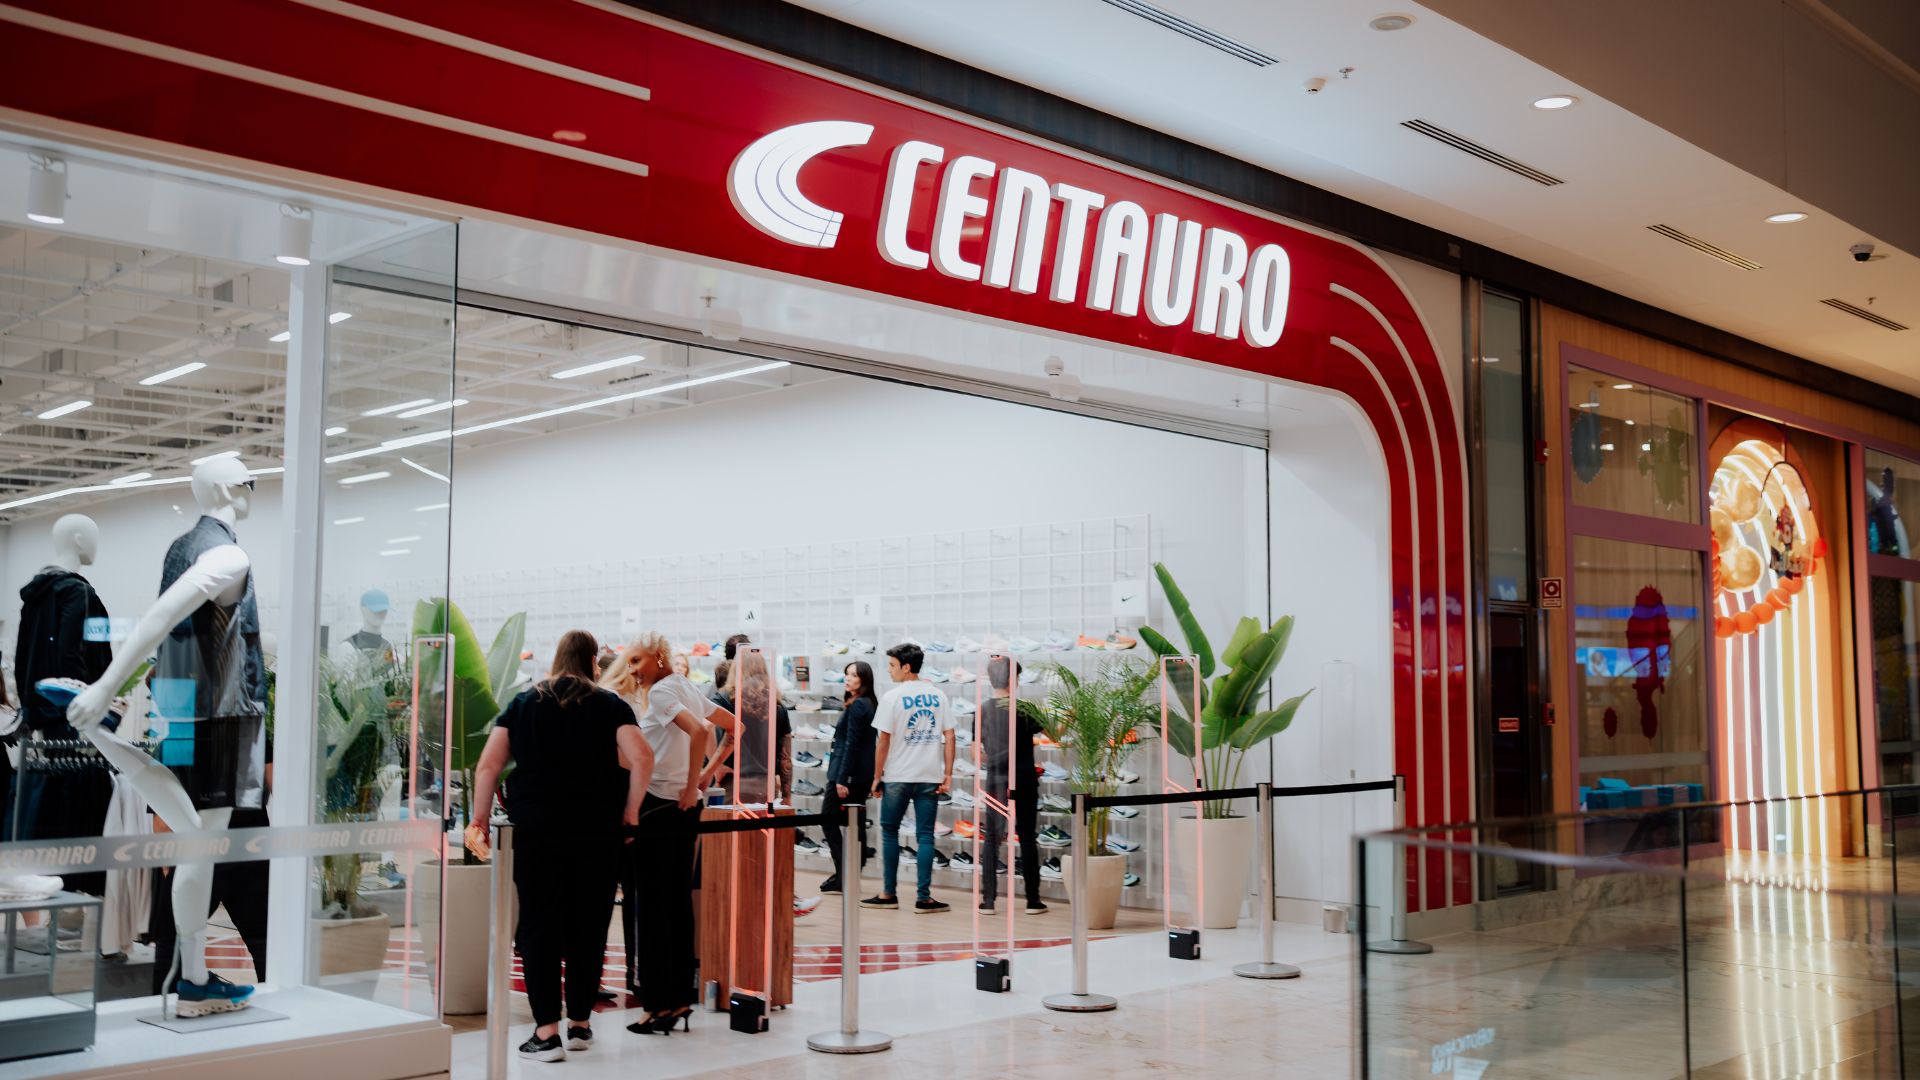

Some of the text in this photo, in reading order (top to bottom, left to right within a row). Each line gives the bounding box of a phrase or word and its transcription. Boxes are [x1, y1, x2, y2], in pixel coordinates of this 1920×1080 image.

[876, 140, 1291, 348] CENTAURO
[902, 693, 940, 710] DEUS
[143, 836, 230, 860] CENTRO
